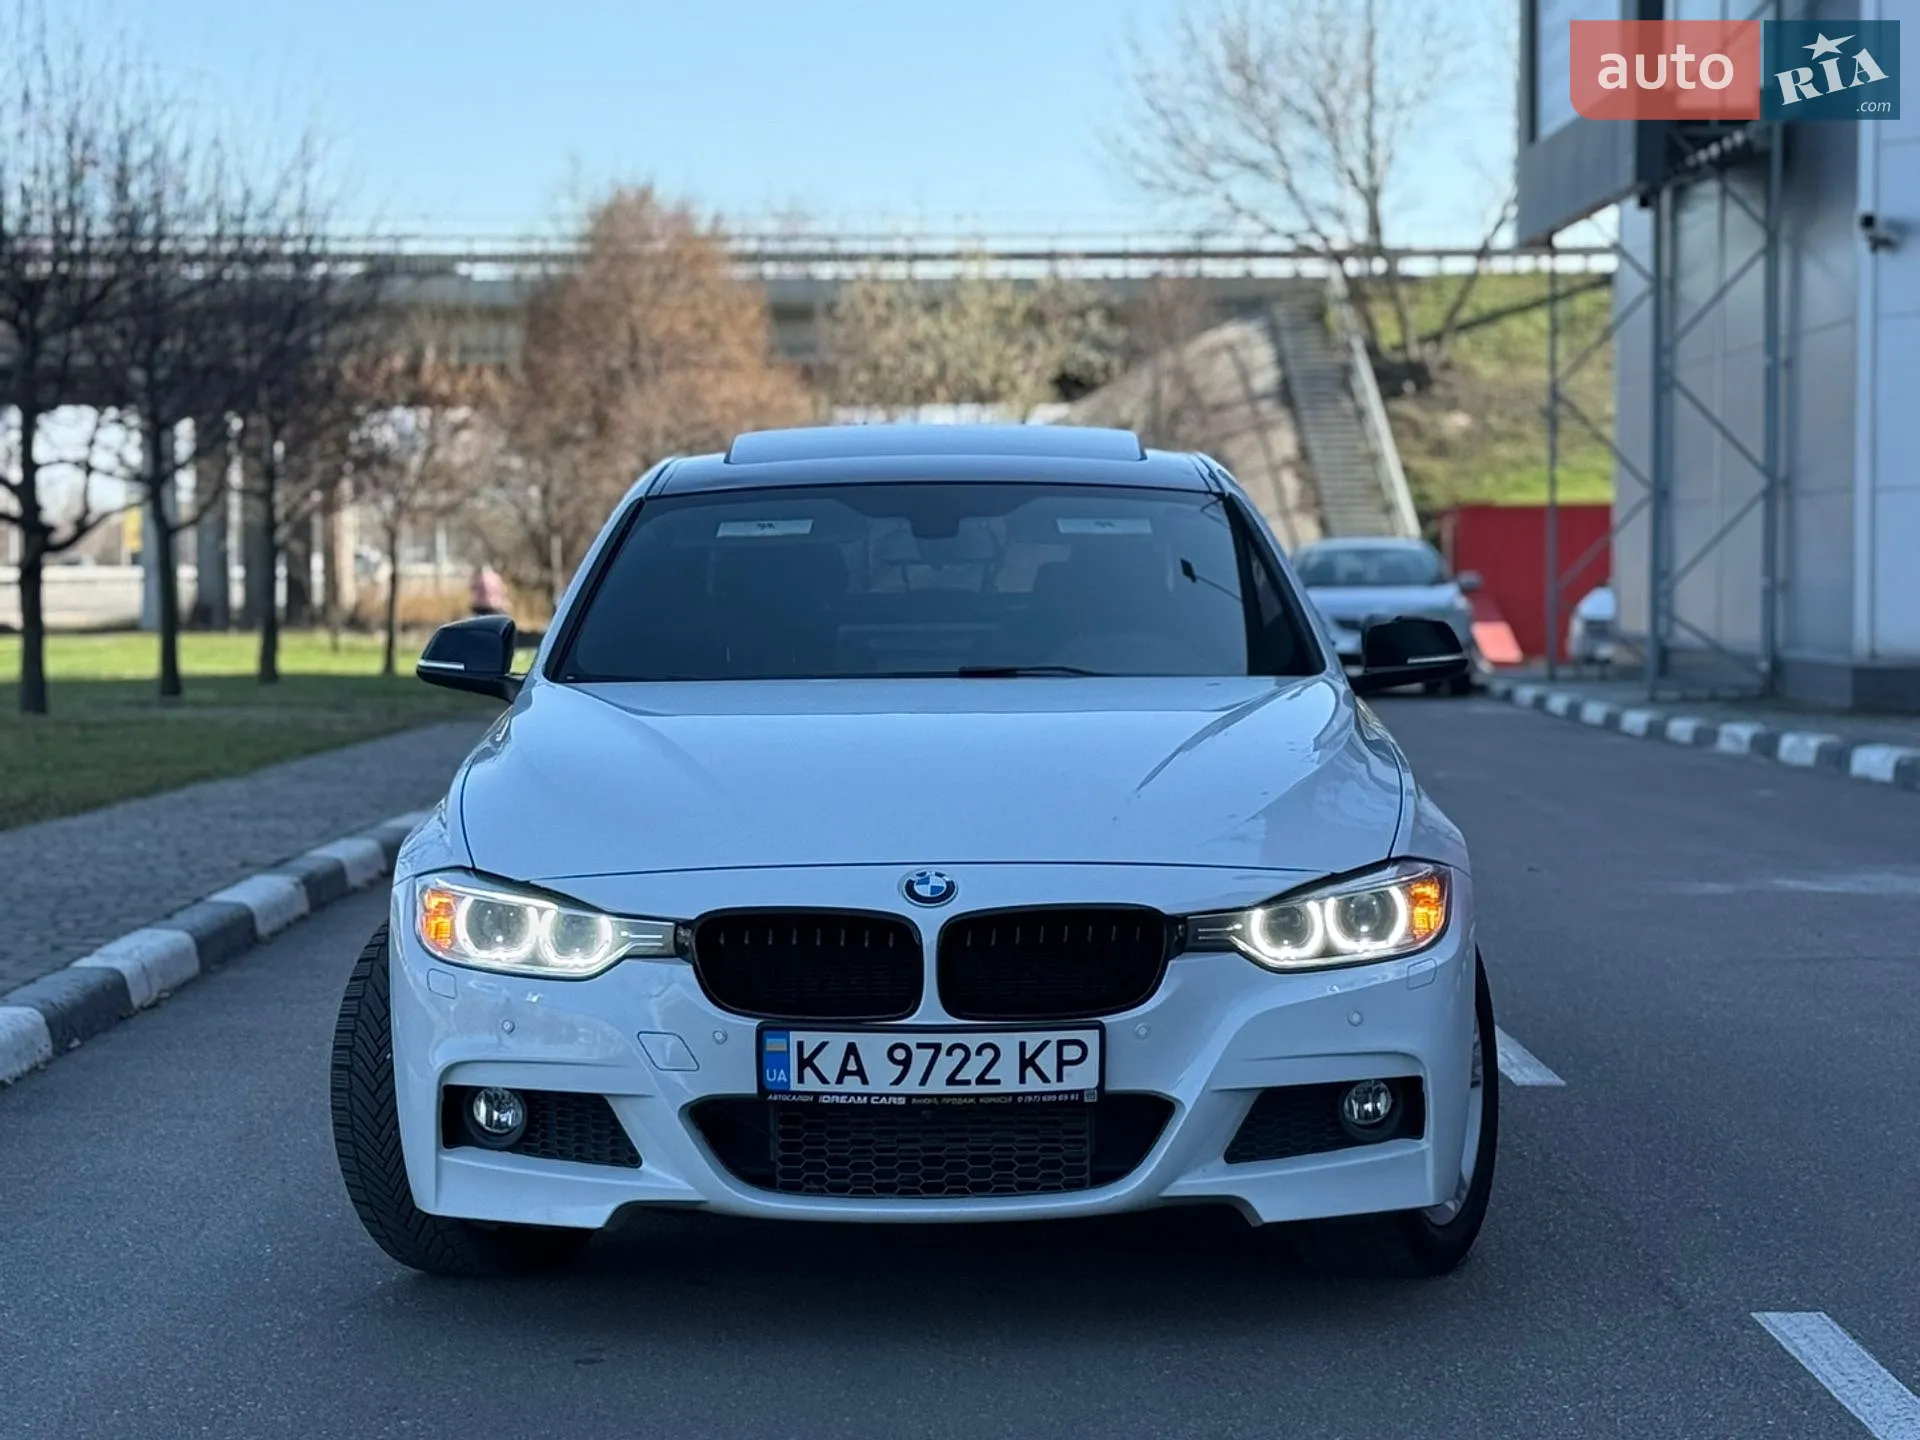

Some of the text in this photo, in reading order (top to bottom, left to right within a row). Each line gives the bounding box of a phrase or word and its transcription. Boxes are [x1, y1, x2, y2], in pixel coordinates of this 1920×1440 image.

[796, 1038, 1089, 1086] KA 9722 KP
[766, 1069, 788, 1083] UA
[870, 1095, 906, 1105] CARS
